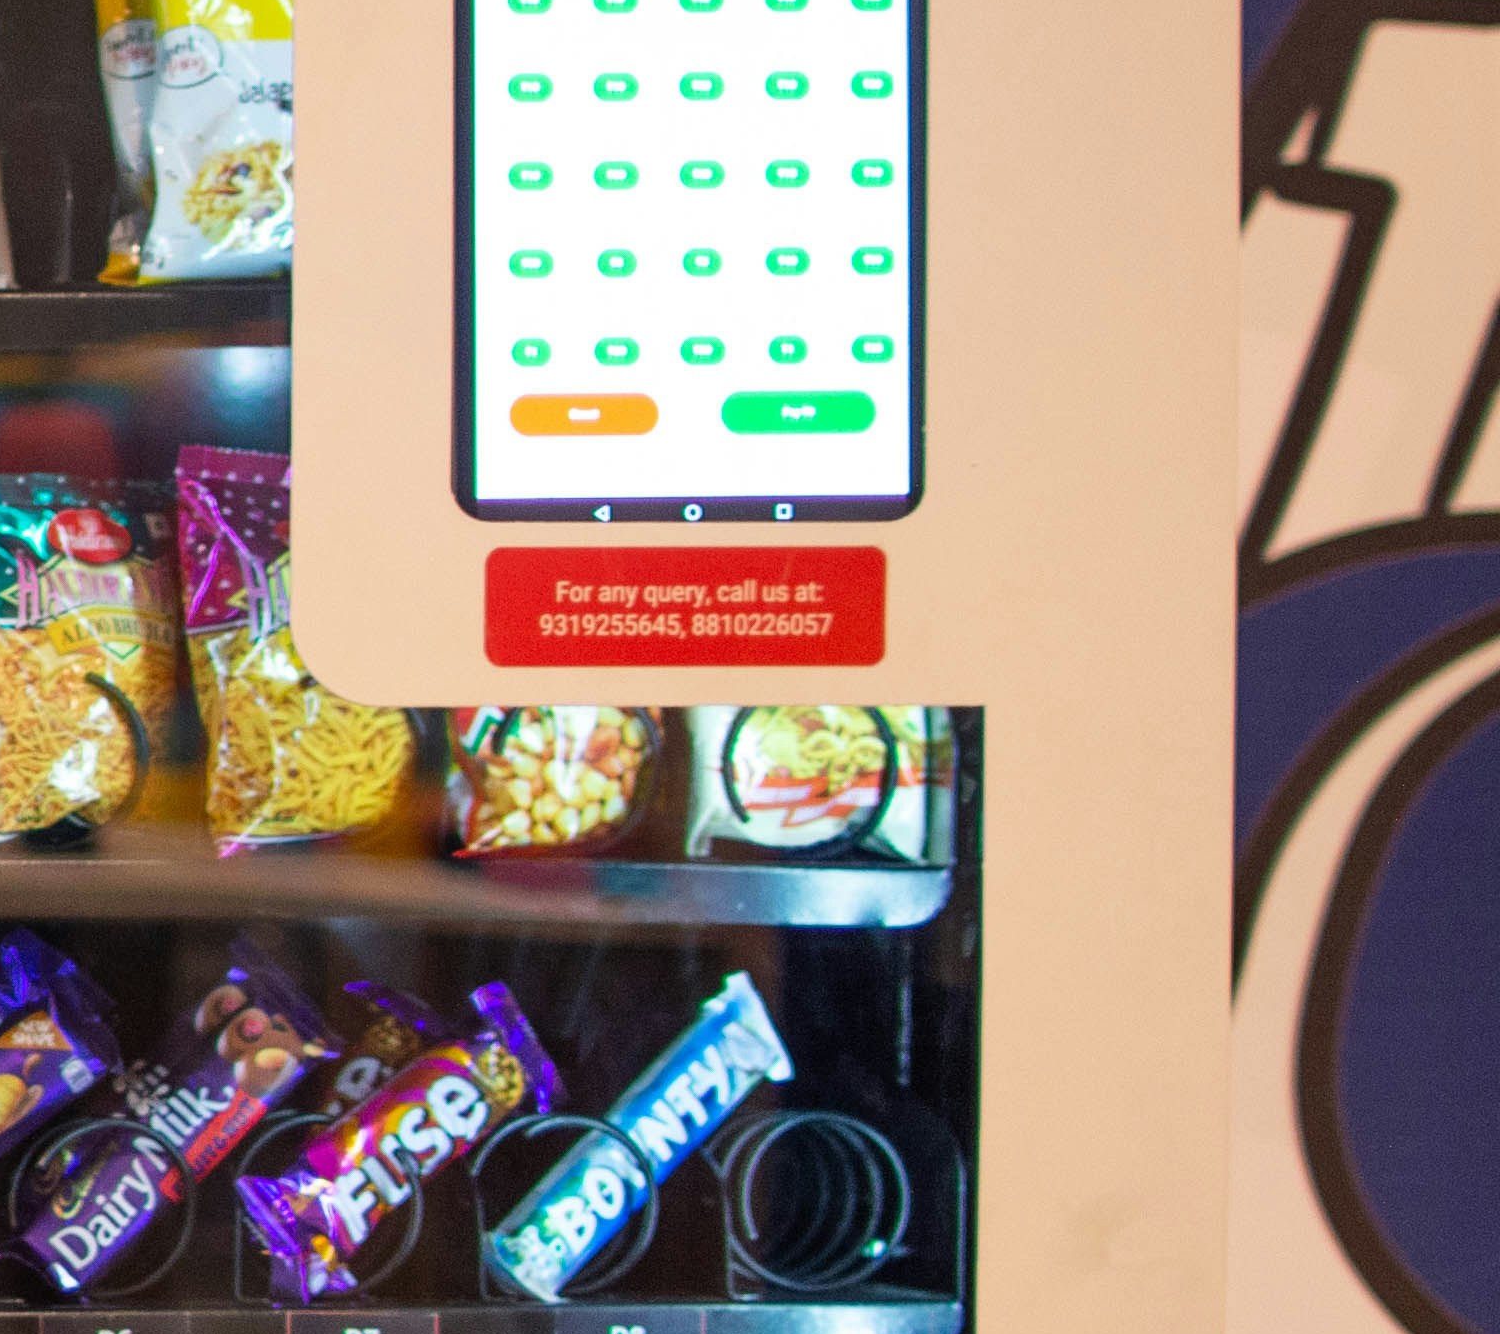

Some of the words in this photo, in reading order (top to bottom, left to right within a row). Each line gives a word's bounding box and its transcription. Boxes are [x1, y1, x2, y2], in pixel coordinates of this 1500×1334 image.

[555, 579, 595, 603] For
[598, 584, 638, 609] any
[644, 584, 712, 610] query,
[716, 579, 757, 603] call
[762, 583, 790, 603] us
[794, 580, 824, 603] at:
[539, 613, 687, 639] 9319255645,
[691, 612, 834, 637] 8810226057
[48, 1158, 160, 1270] Dairy
[131, 1086, 219, 1170] Milk
